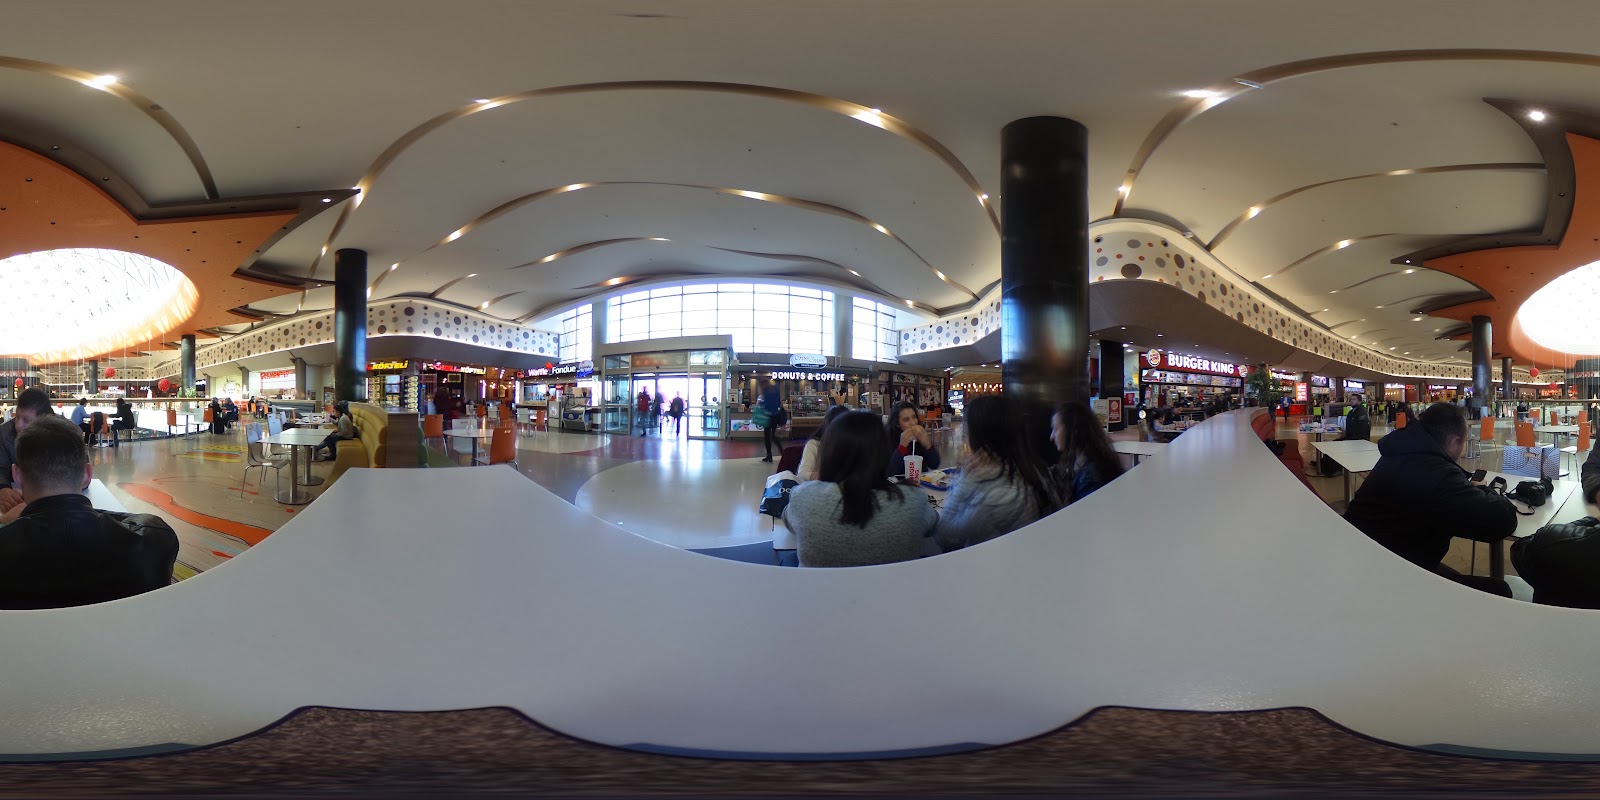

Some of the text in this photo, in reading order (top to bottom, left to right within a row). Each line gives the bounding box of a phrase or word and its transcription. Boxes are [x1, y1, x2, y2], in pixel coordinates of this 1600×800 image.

[1168, 354, 1210, 371] BURGER
[1211, 361, 1234, 374] KING
[528, 365, 576, 377] Waffle Fondue
[772, 371, 845, 381] DONUTS & COFFEE
